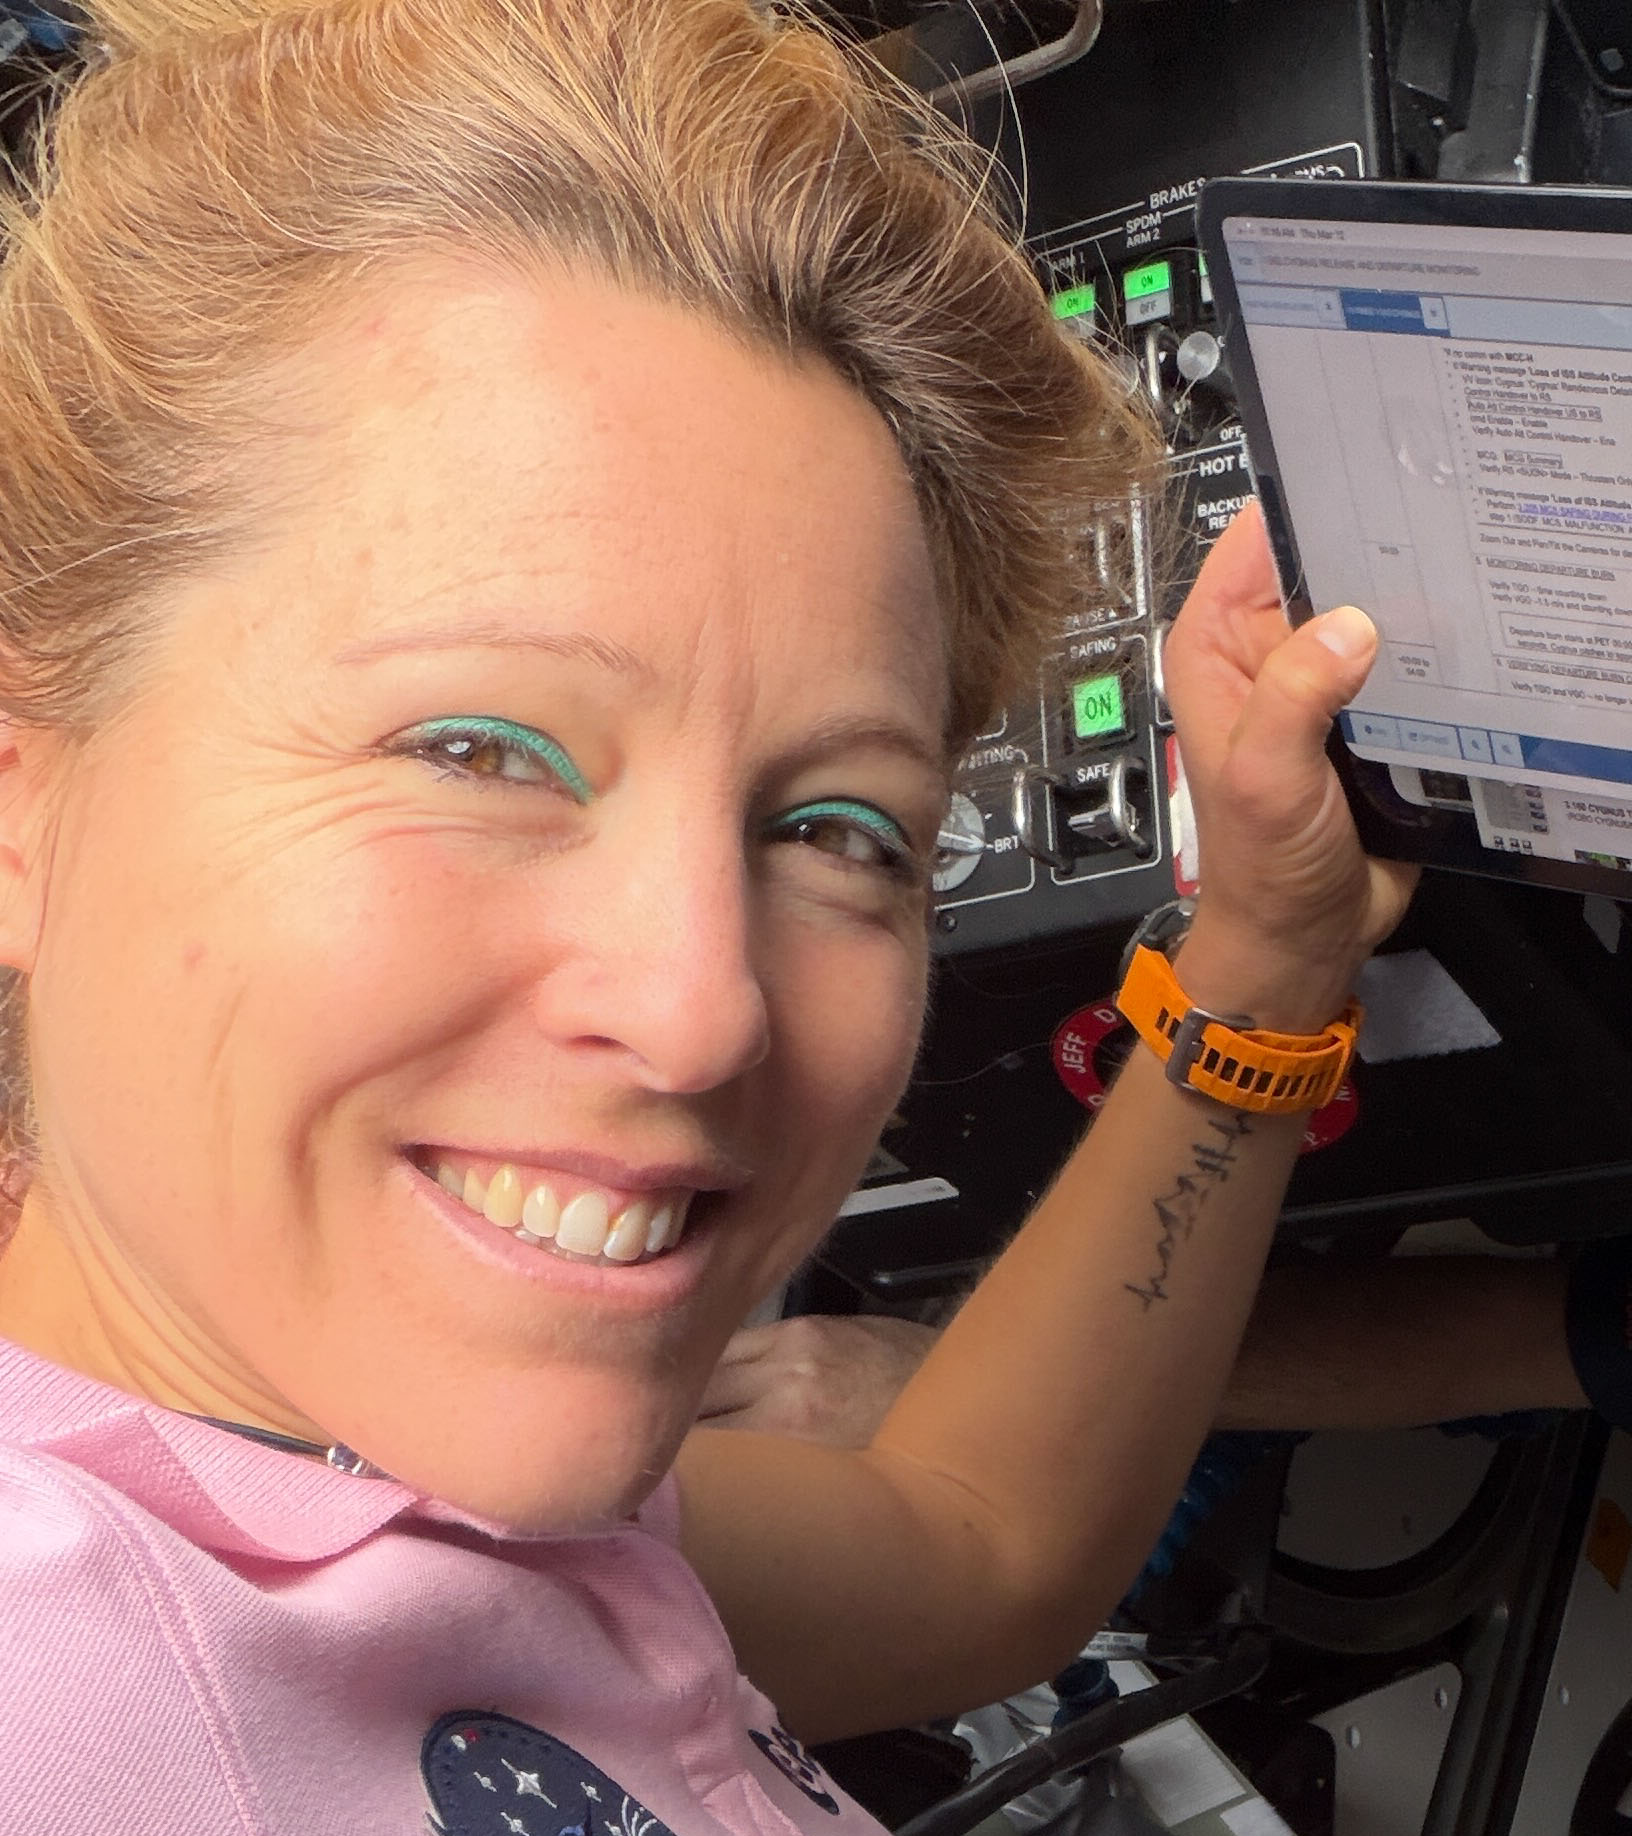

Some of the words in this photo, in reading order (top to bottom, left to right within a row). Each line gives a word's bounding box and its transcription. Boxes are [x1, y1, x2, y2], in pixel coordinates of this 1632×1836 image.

[1126, 210, 1162, 235] SPDM
[1126, 232, 1152, 249] ARM
[1151, 228, 1161, 242] 2
[1141, 274, 1154, 287] ON
[1067, 297, 1079, 310] ON
[1139, 302, 1157, 315] OFF
[1505, 352, 1534, 363] MCC-H
[1200, 455, 1236, 475] HOT
[1069, 636, 1117, 659] SAFING
[1083, 694, 1114, 721] ON
[1075, 762, 1111, 783] SAFE
[1588, 802, 1625, 819] CYGNUS
[994, 835, 1019, 854] BRT
[1061, 1032, 1088, 1074] JEFF
